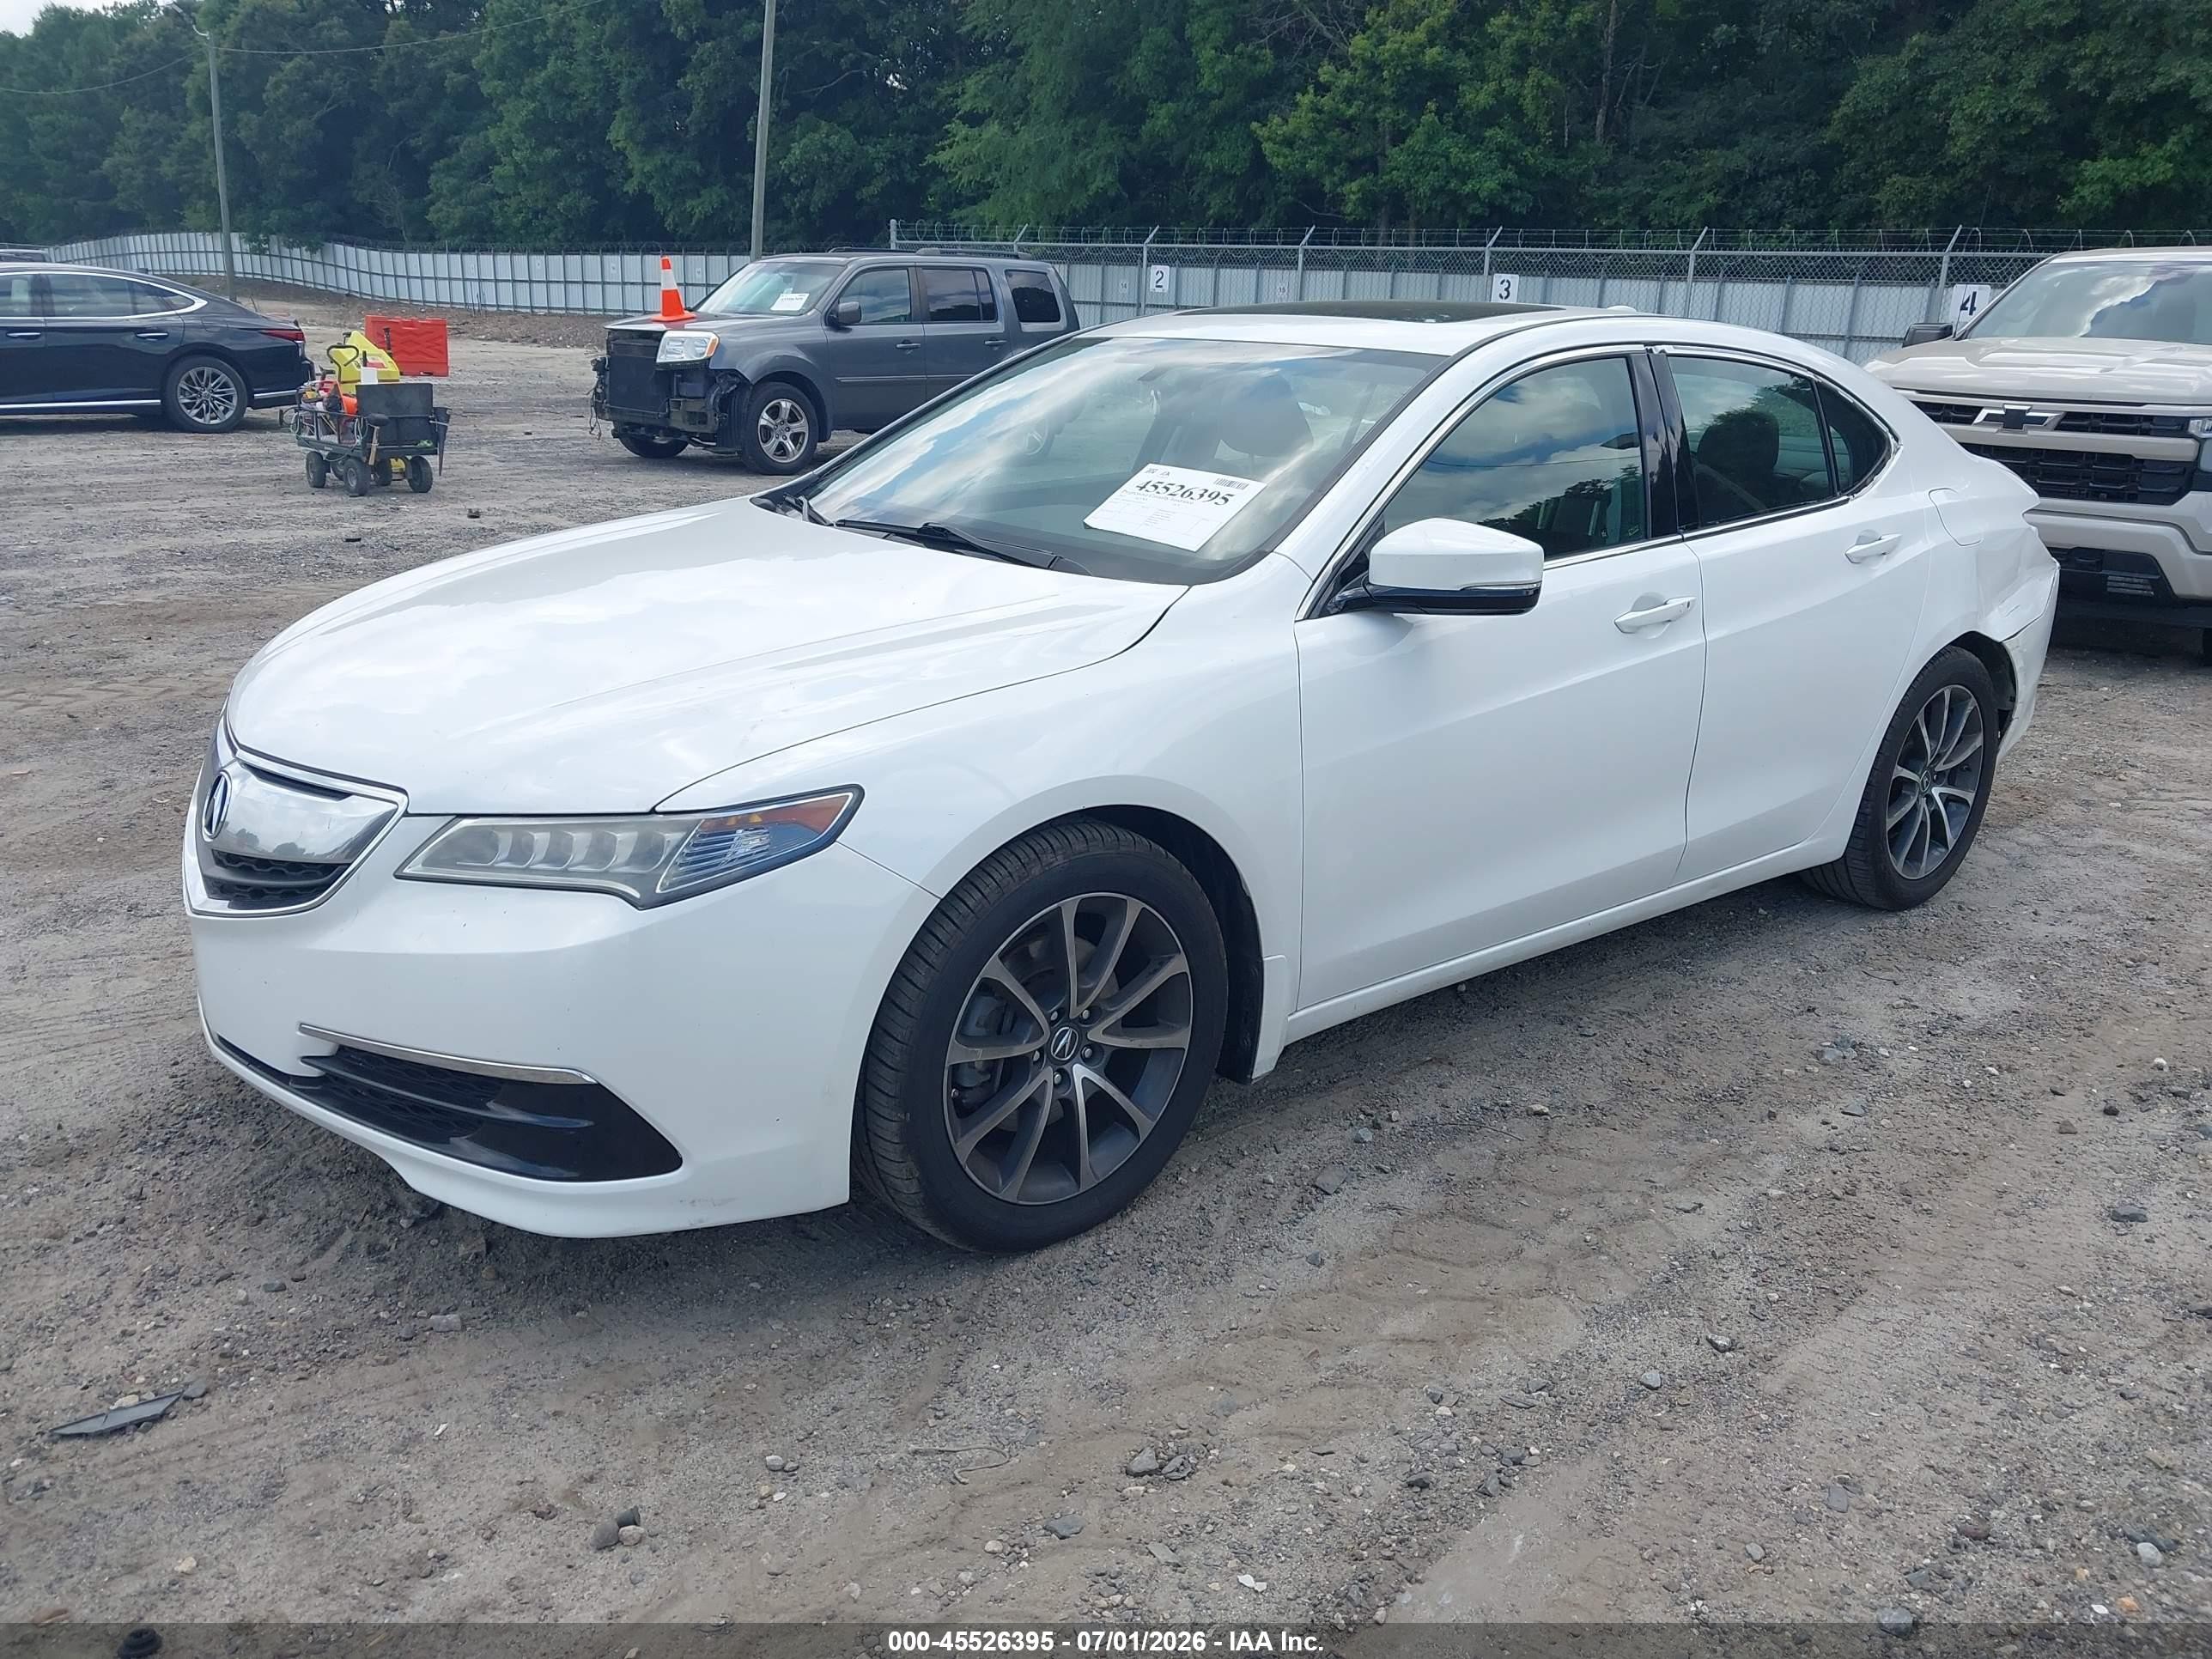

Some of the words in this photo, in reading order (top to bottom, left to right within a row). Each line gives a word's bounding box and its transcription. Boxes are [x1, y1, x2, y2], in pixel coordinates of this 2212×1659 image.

[1155, 270, 1164, 289] 2
[1498, 278, 1511, 301] 3
[1960, 290, 1978, 316] 4
[1135, 479, 1236, 506] 45526395
